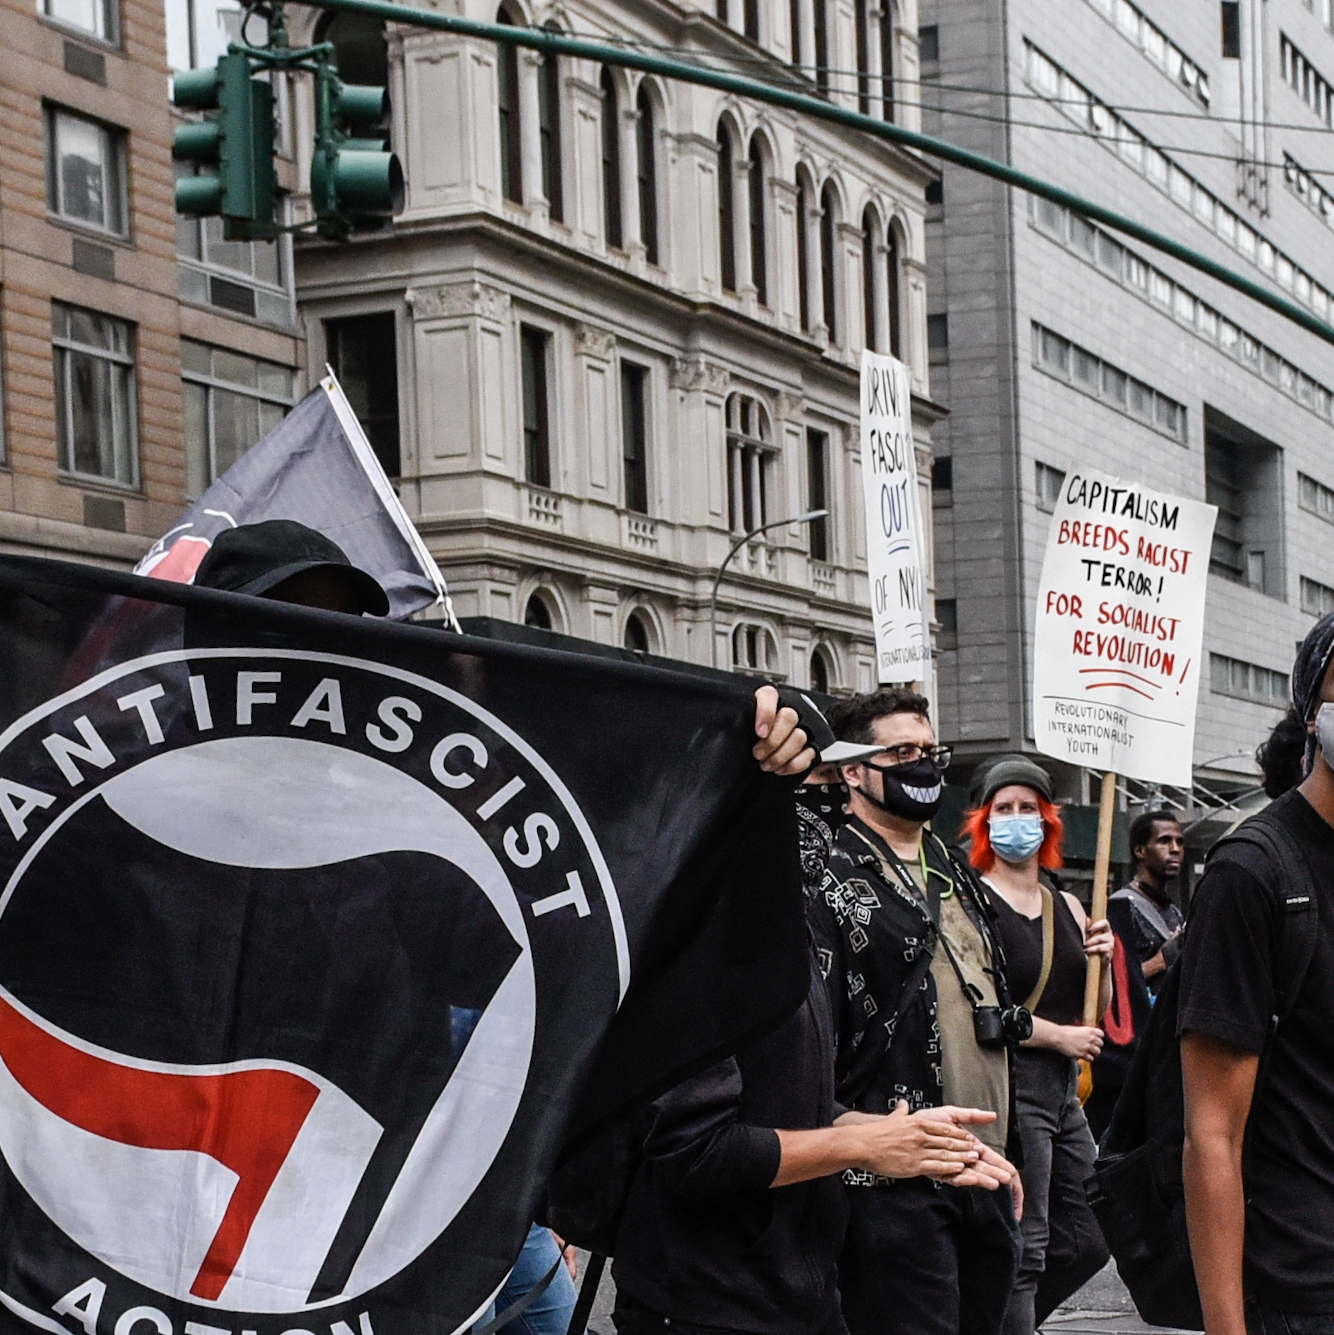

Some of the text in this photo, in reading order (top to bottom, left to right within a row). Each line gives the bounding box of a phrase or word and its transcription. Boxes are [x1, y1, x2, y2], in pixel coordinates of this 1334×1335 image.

[881, 478, 910, 538] OUT
[1067, 475, 1179, 530] CAPITALISM
[1057, 520, 1193, 574] BREEDS RACIST
[875, 575, 888, 615] OF
[1081, 559, 1164, 603] TERROR!
[1046, 590, 1182, 641] FOR SOCIALIST
[1072, 630, 1192, 696] REVOLUTION!
[1048, 719, 1134, 748] INTERNATIONALIST
[1054, 701, 1129, 731] REVOLUTIONARY
[1066, 737, 1099, 756] YOUTH
